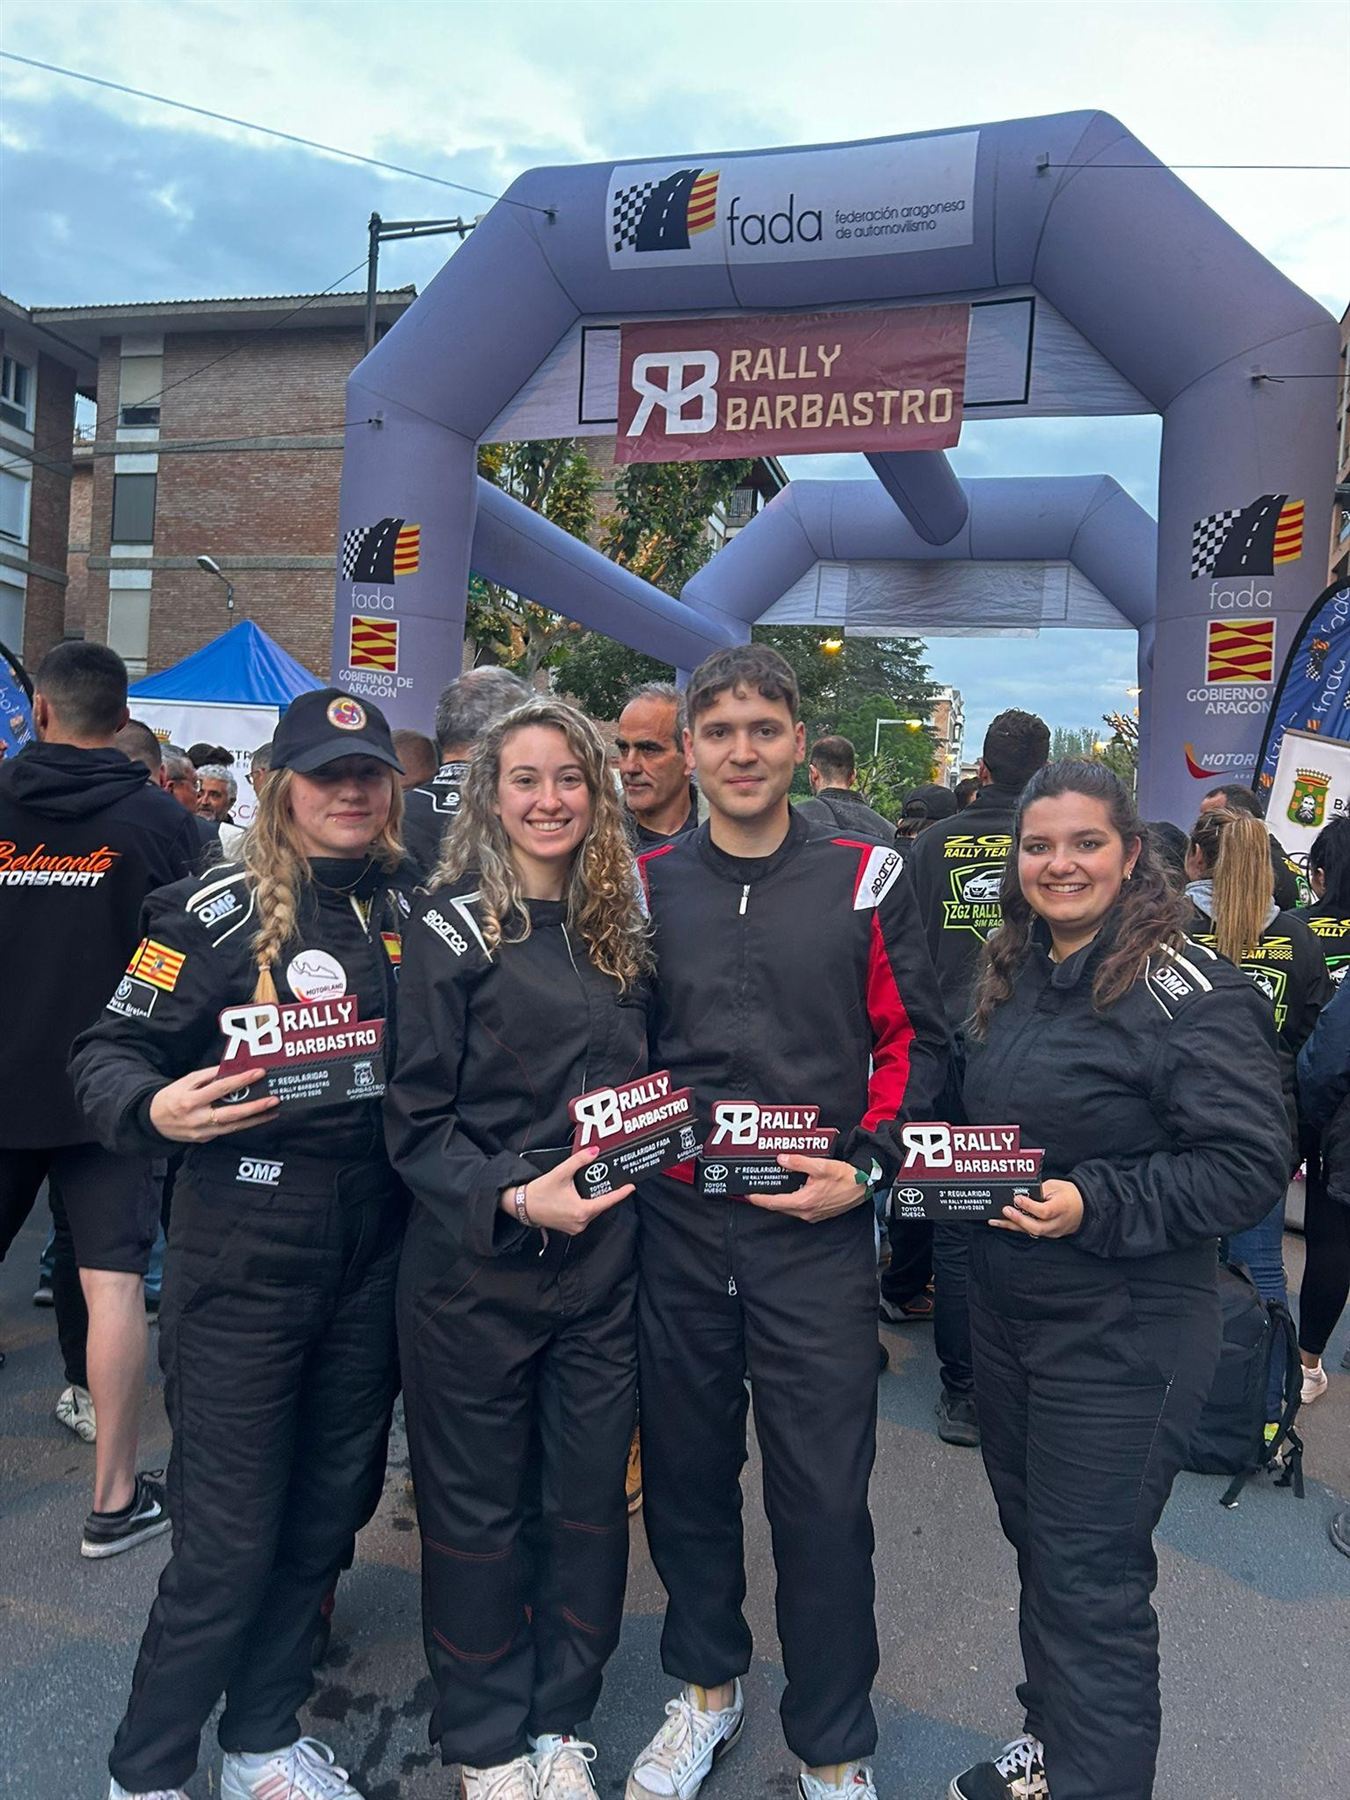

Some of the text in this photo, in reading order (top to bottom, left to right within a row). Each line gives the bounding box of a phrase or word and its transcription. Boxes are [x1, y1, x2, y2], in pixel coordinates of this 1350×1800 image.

[727, 193, 823, 246] fada
[835, 199, 965, 224] federación aragonesa
[836, 218, 937, 240] de automovilismo
[729, 344, 842, 382] RALLY
[725, 387, 953, 431] BARBASTRO
[351, 585, 395, 610] fada
[1209, 580, 1272, 609] fada
[339, 669, 414, 688] GOBIERNO DE
[348, 682, 397, 698] ARAGON
[1186, 687, 1267, 701] GOBIERNO
[1201, 753, 1259, 766] MOTOR
[944, 834, 1013, 847] ZG
[944, 847, 1009, 858] RALLY TEA
[0, 870, 104, 887] TORSPORT
[199, 893, 236, 922] OMP
[950, 904, 971, 919] ZGZ
[974, 919, 988, 927] SIM
[1156, 968, 1189, 995] OMP
[282, 1002, 352, 1032] RALLY
[284, 1029, 377, 1057] BARBASTRO
[278, 1070, 328, 1085] REGULARIDAD
[280, 1086, 297, 1094] RALLY
[297, 1080, 330, 1091] BARBASTRO
[619, 1076, 669, 1111] RALLY
[623, 1098, 689, 1134] BARBASTRO
[760, 1111, 816, 1129] RALLY
[758, 1137, 829, 1150] BARBASTRO
[953, 1132, 1015, 1151] RALLY
[238, 1161, 282, 1181] OMP
[955, 1159, 1035, 1173] BARBASTRO
[590, 1180, 612, 1192] TOYOTA
